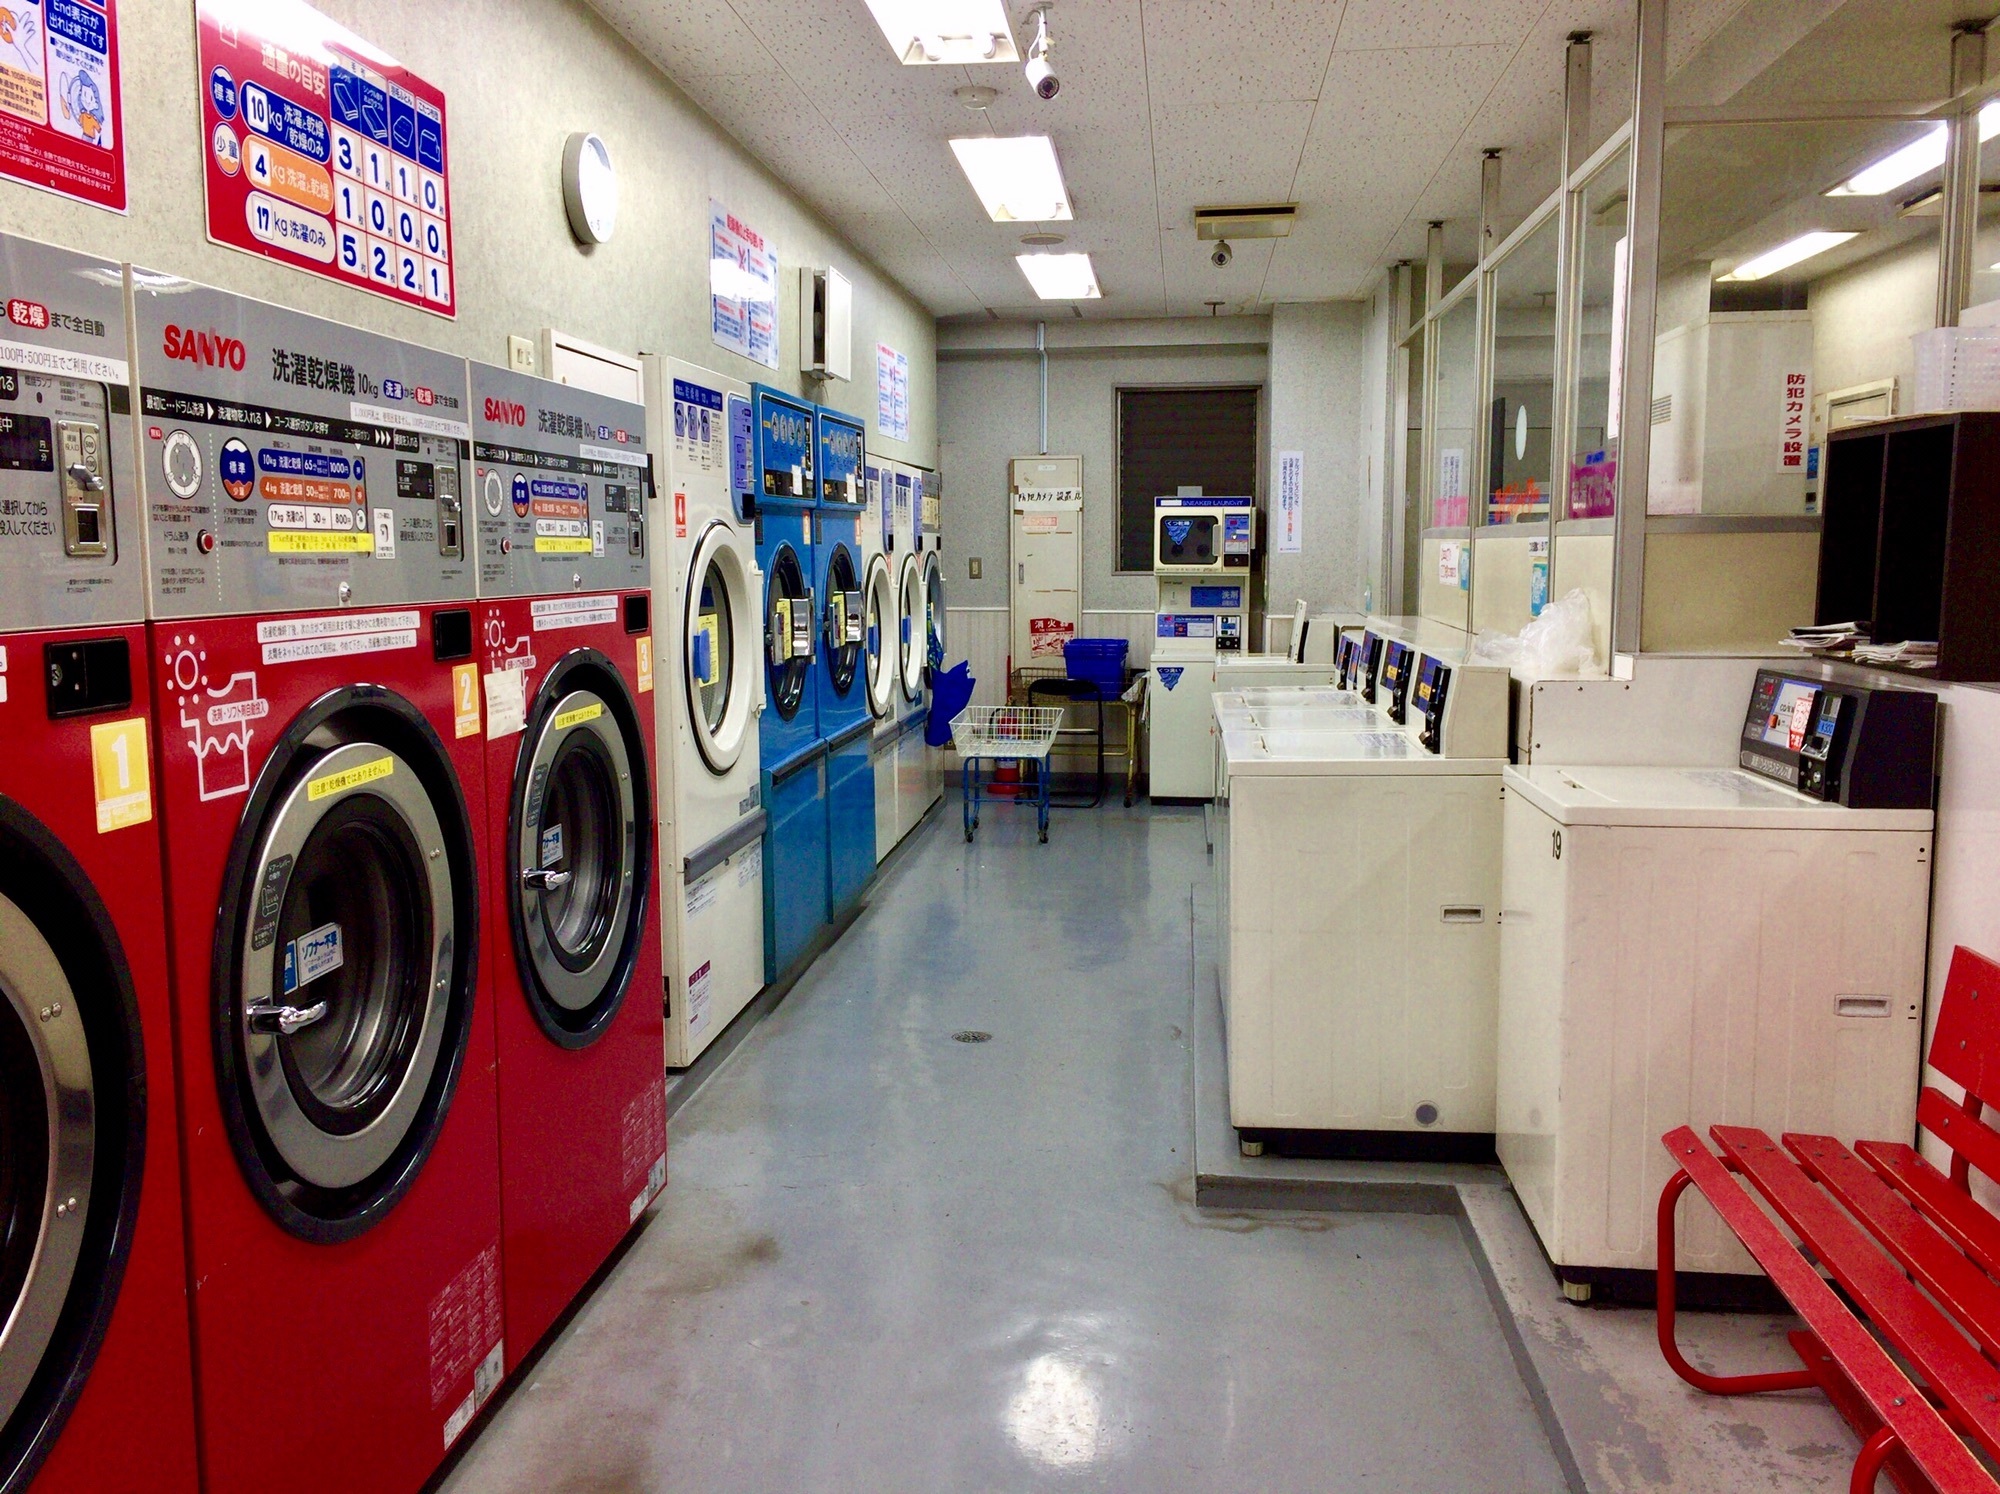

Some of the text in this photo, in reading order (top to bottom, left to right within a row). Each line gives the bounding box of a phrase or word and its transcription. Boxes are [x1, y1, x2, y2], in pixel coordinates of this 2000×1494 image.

[54, 0, 99, 29] End表示が
[49, 12, 104, 49] 出れば終了です
[262, 45, 326, 99] 適量の目安
[213, 82, 236, 106] 標準
[283, 102, 325, 139] 洗濯と乾燥
[216, 135, 238, 160] 少量
[287, 166, 330, 202] 洗濯と乾燥
[289, 219, 327, 247] 洗濯のみ
[12, 300, 45, 327] 乾燥
[50, 312, 105, 337] まで全自動
[163, 324, 246, 372] SANYO
[272, 348, 379, 399] 洗濯乾燥機 10kg
[384, 381, 403, 399] 洗濯
[416, 388, 433, 405] 乾燥
[434, 394, 459, 409] まで全自動
[217, 406, 262, 425] 洗濯物を入れる
[484, 397, 526, 428] SANYO
[538, 408, 584, 440] 洗濯乾燥機
[1782, 373, 1806, 467] 防犯カメラ設置
[229, 460, 246, 476] 標準
[263, 453, 277, 468] 10kg
[265, 480, 277, 496] 4kg
[270, 509, 284, 523] 17kg
[163, 530, 189, 543] ドラム洗浄
[641, 643, 649, 673] 3
[460, 672, 471, 711] 2
[111, 733, 130, 790] 1
[1551, 828, 1562, 861] 19
